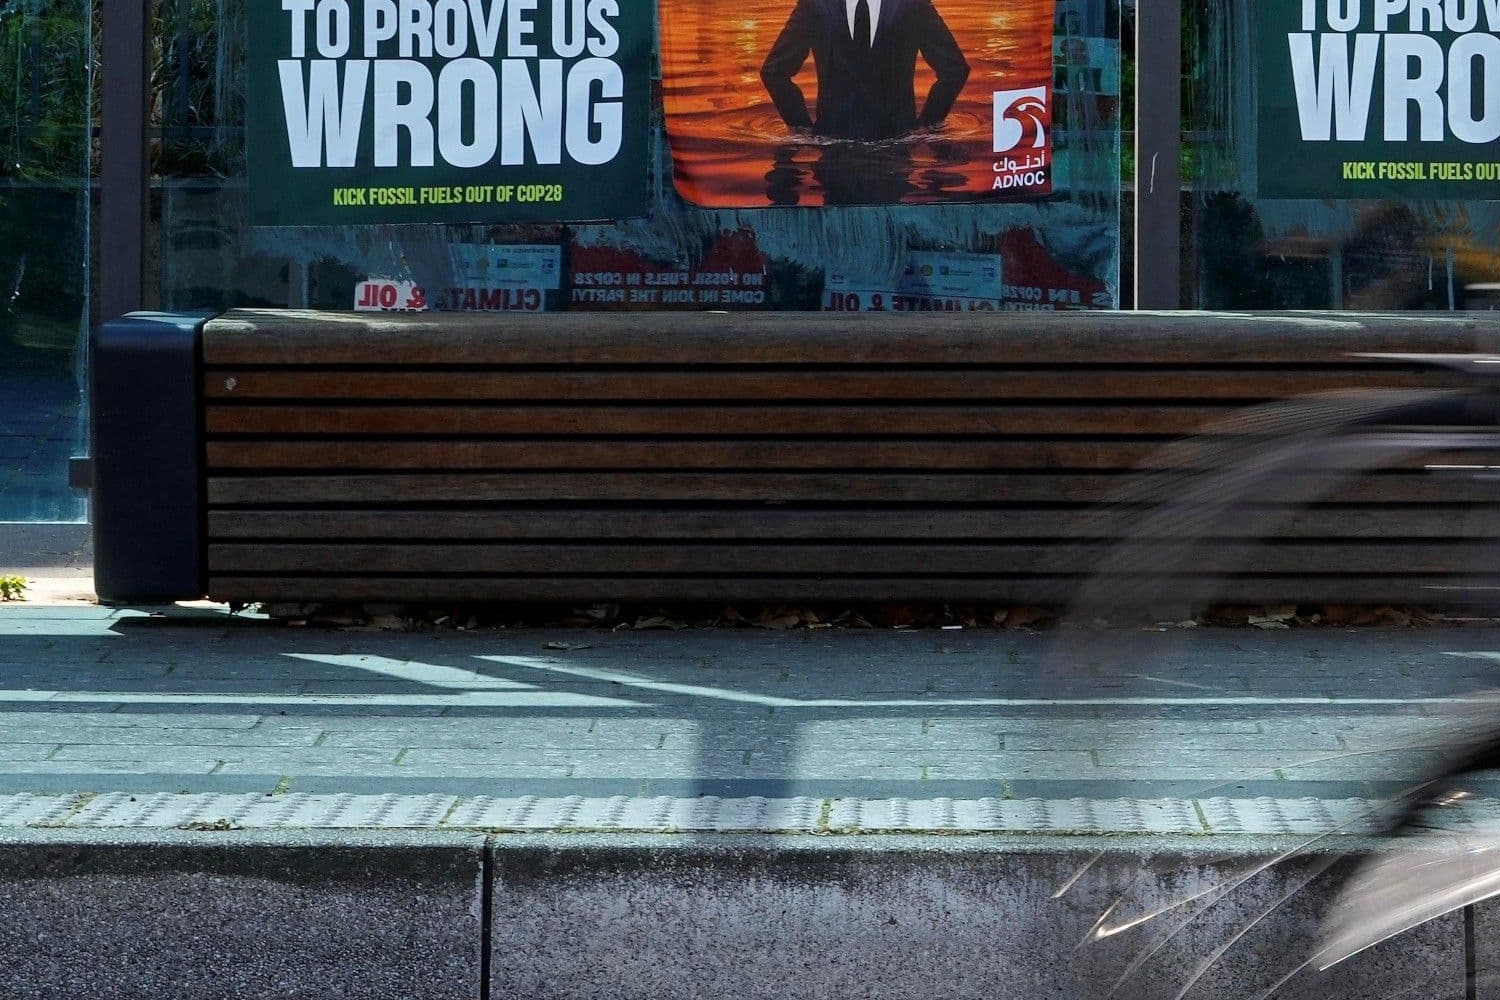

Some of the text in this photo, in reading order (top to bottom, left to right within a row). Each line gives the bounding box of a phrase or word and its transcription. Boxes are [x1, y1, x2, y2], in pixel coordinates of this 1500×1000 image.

[278, 57, 624, 168] WRONG
[993, 172, 1045, 190] ADNOC
[1343, 162, 1376, 181] KICK
[1379, 162, 1426, 180] FOSSIL
[1429, 162, 1472, 181] FUELS
[334, 184, 562, 206] KICK FOSSIL FUELS OUT OF COP28
